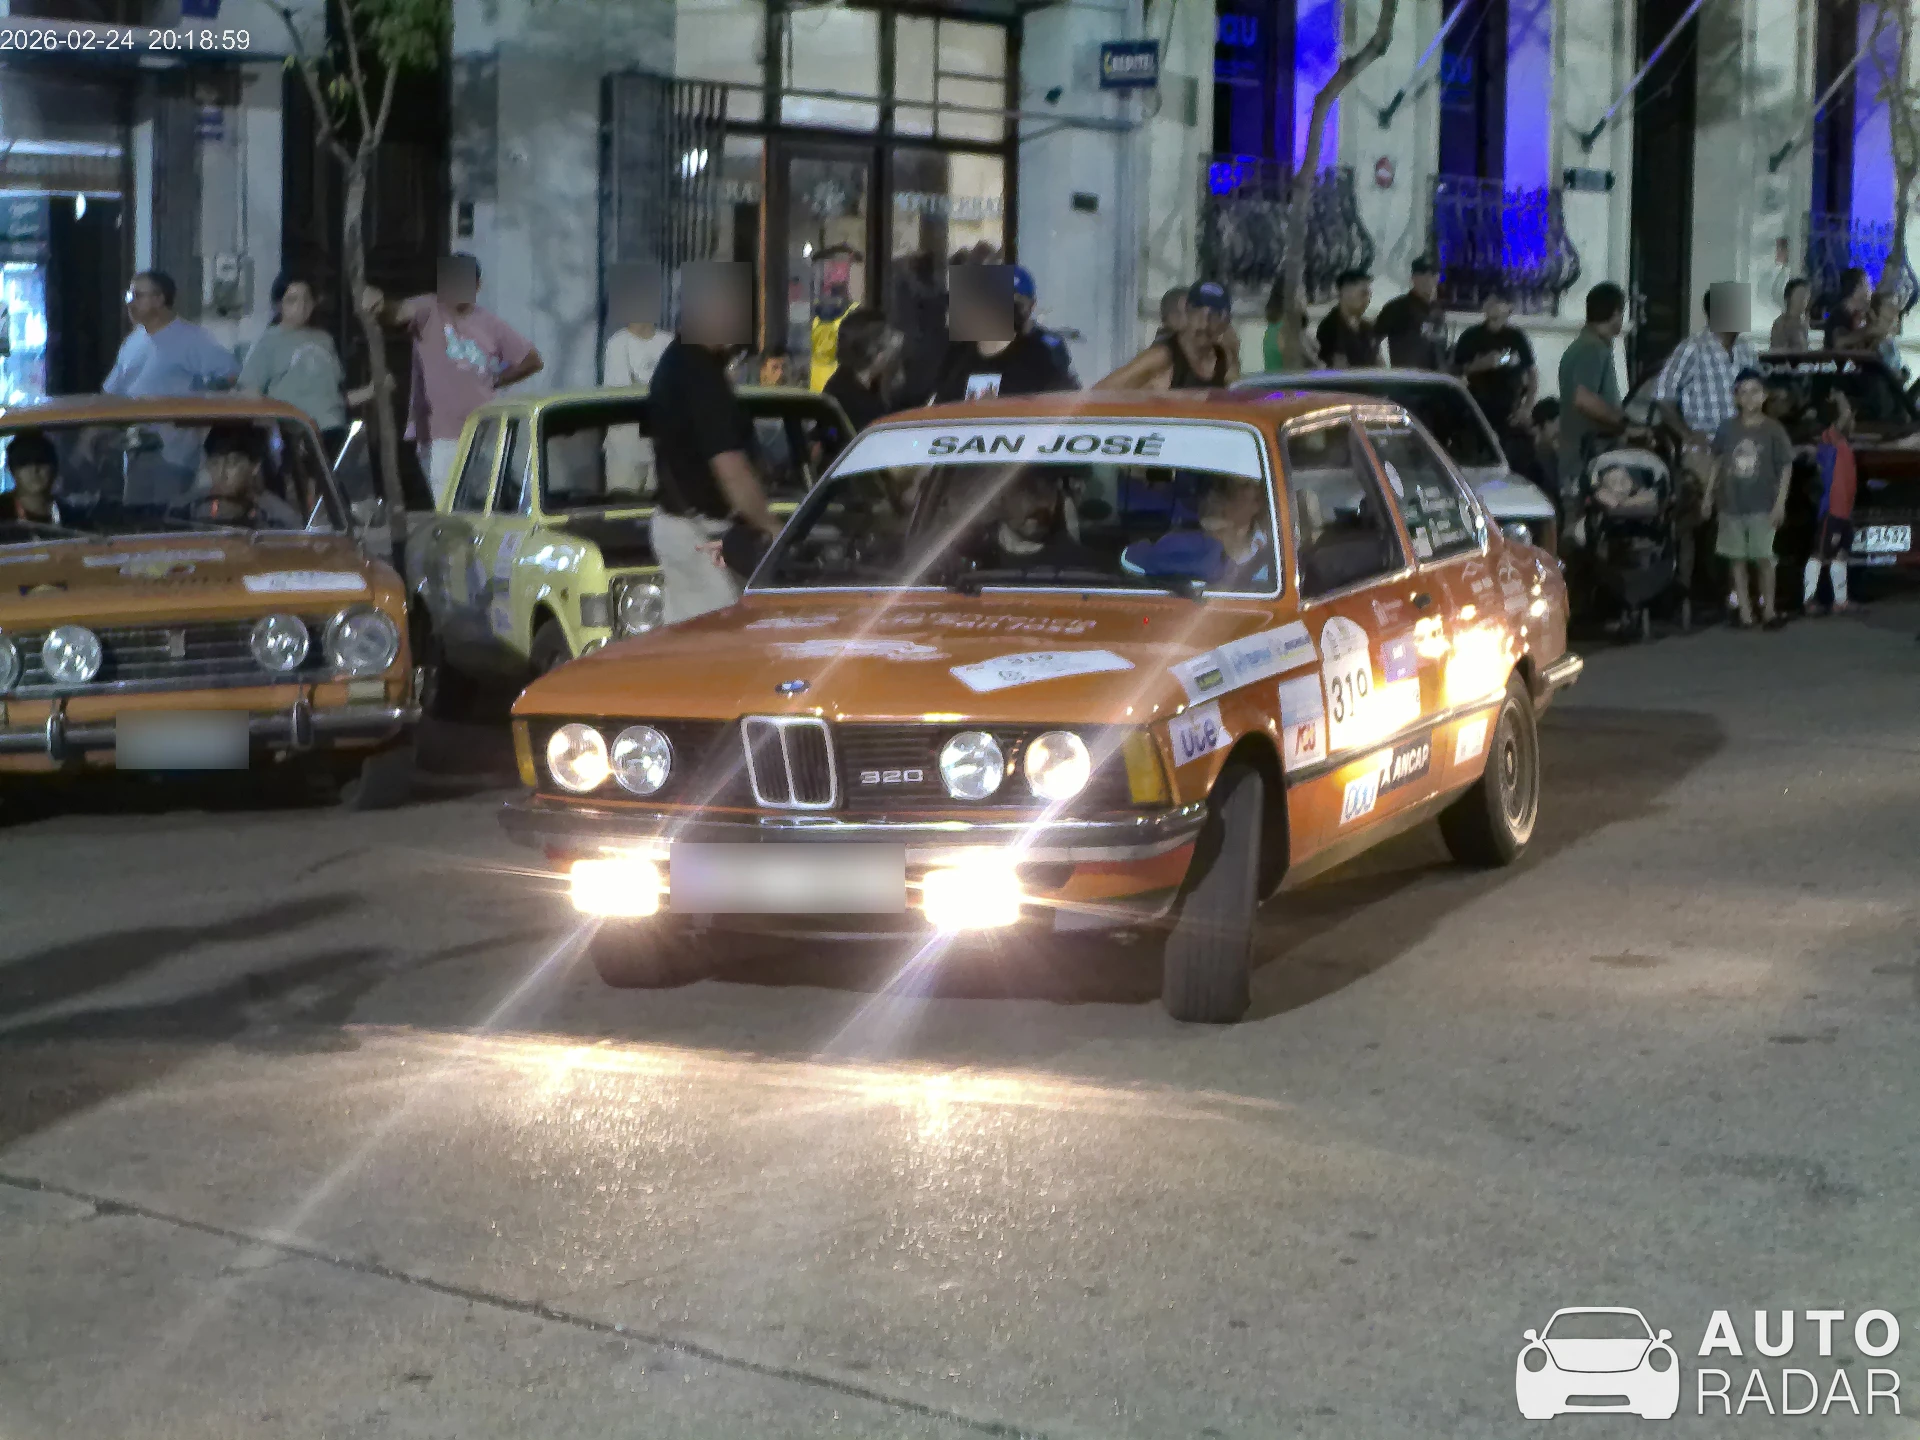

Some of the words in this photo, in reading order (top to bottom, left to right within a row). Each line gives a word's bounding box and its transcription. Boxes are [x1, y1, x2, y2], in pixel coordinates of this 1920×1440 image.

[927, 433, 1026, 456] SAN
[1037, 431, 1166, 457] JOSÉ
[1392, 744, 1430, 782] ANCAP
[860, 768, 925, 785] 320
